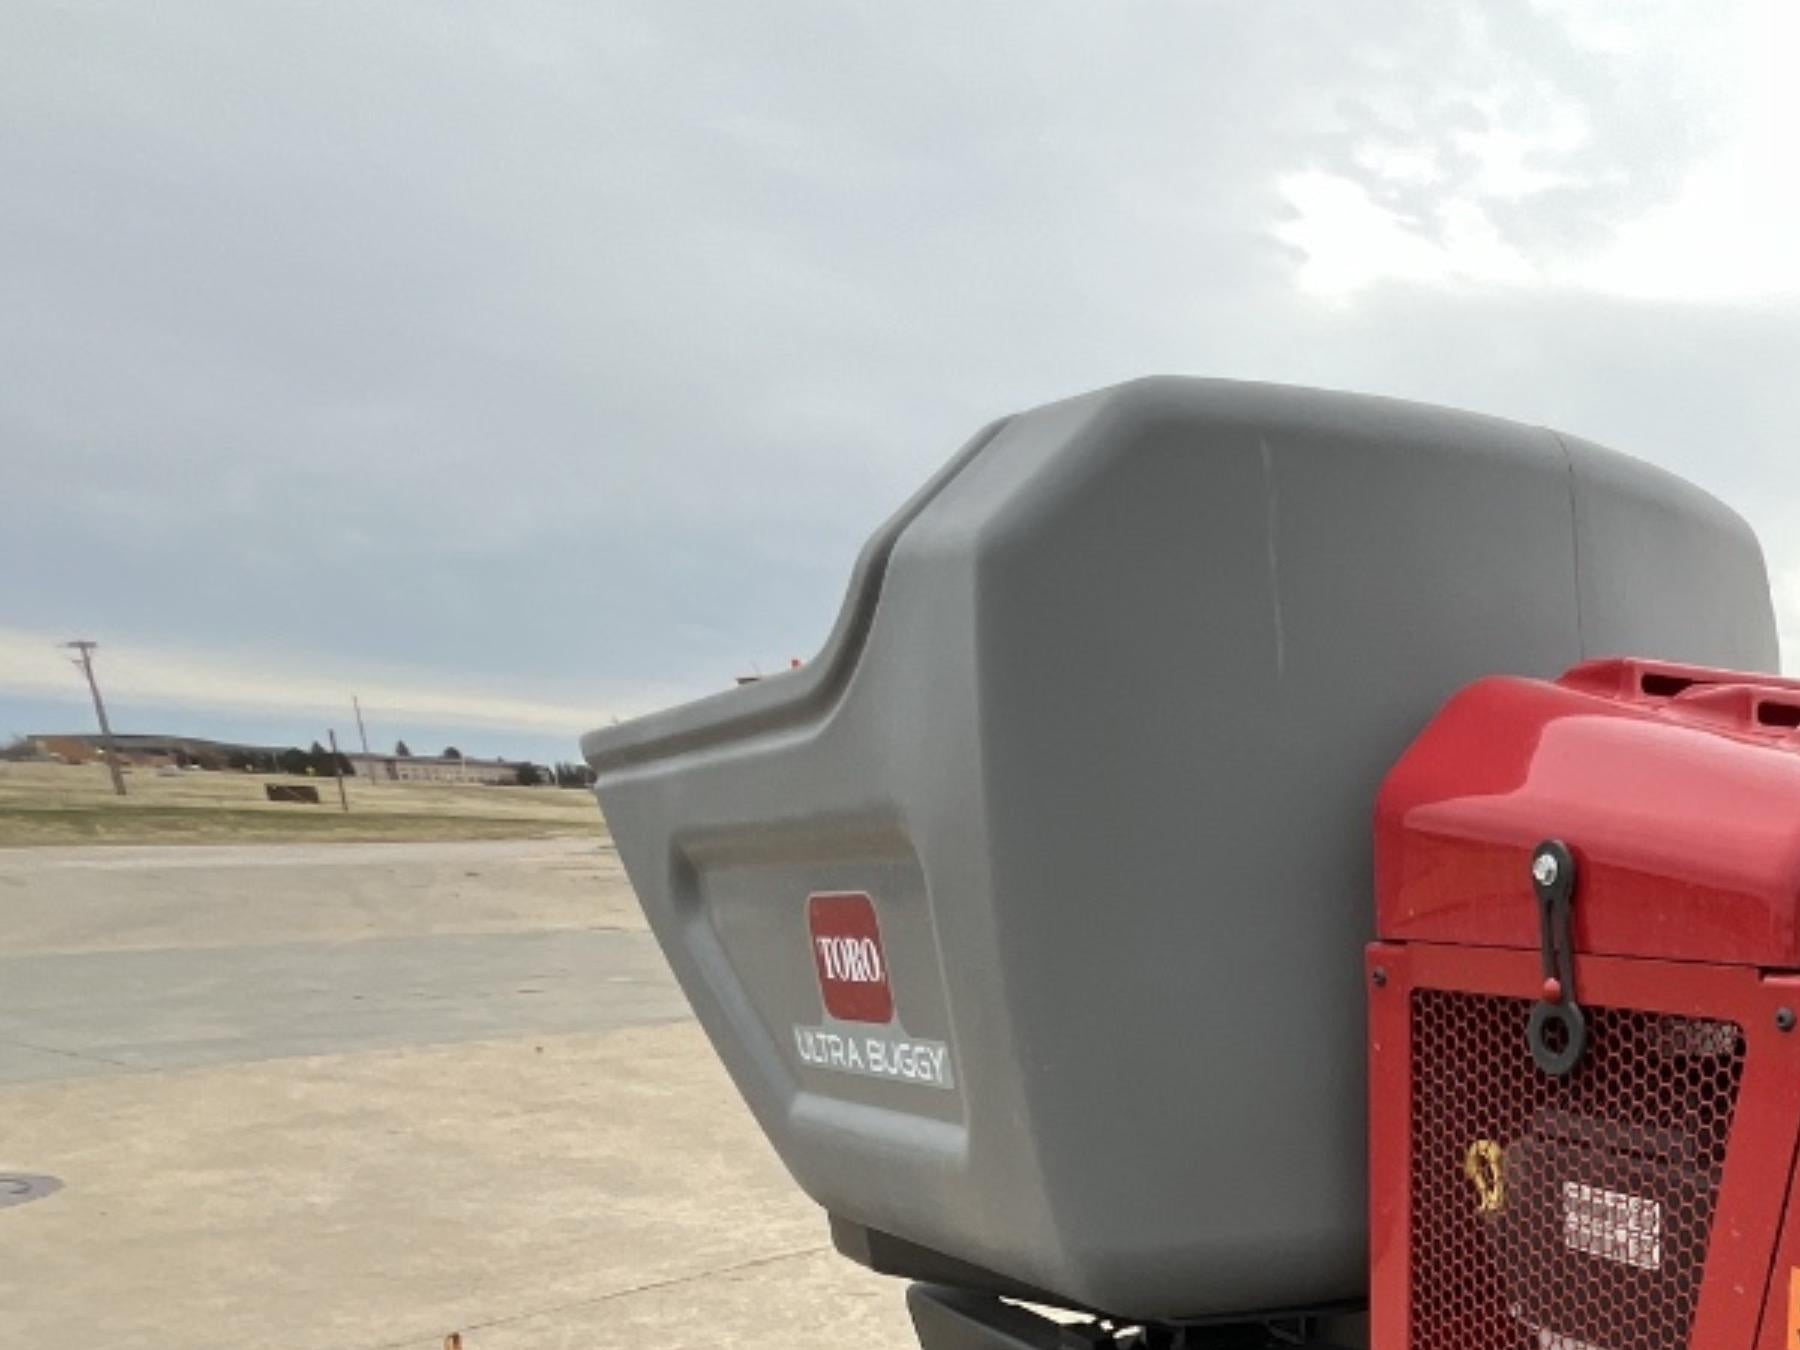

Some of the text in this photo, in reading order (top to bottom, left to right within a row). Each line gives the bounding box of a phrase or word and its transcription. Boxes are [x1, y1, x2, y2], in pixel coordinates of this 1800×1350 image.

[816, 936, 882, 982] TORO
[794, 1028, 947, 1083] ULTRA BUGGY
